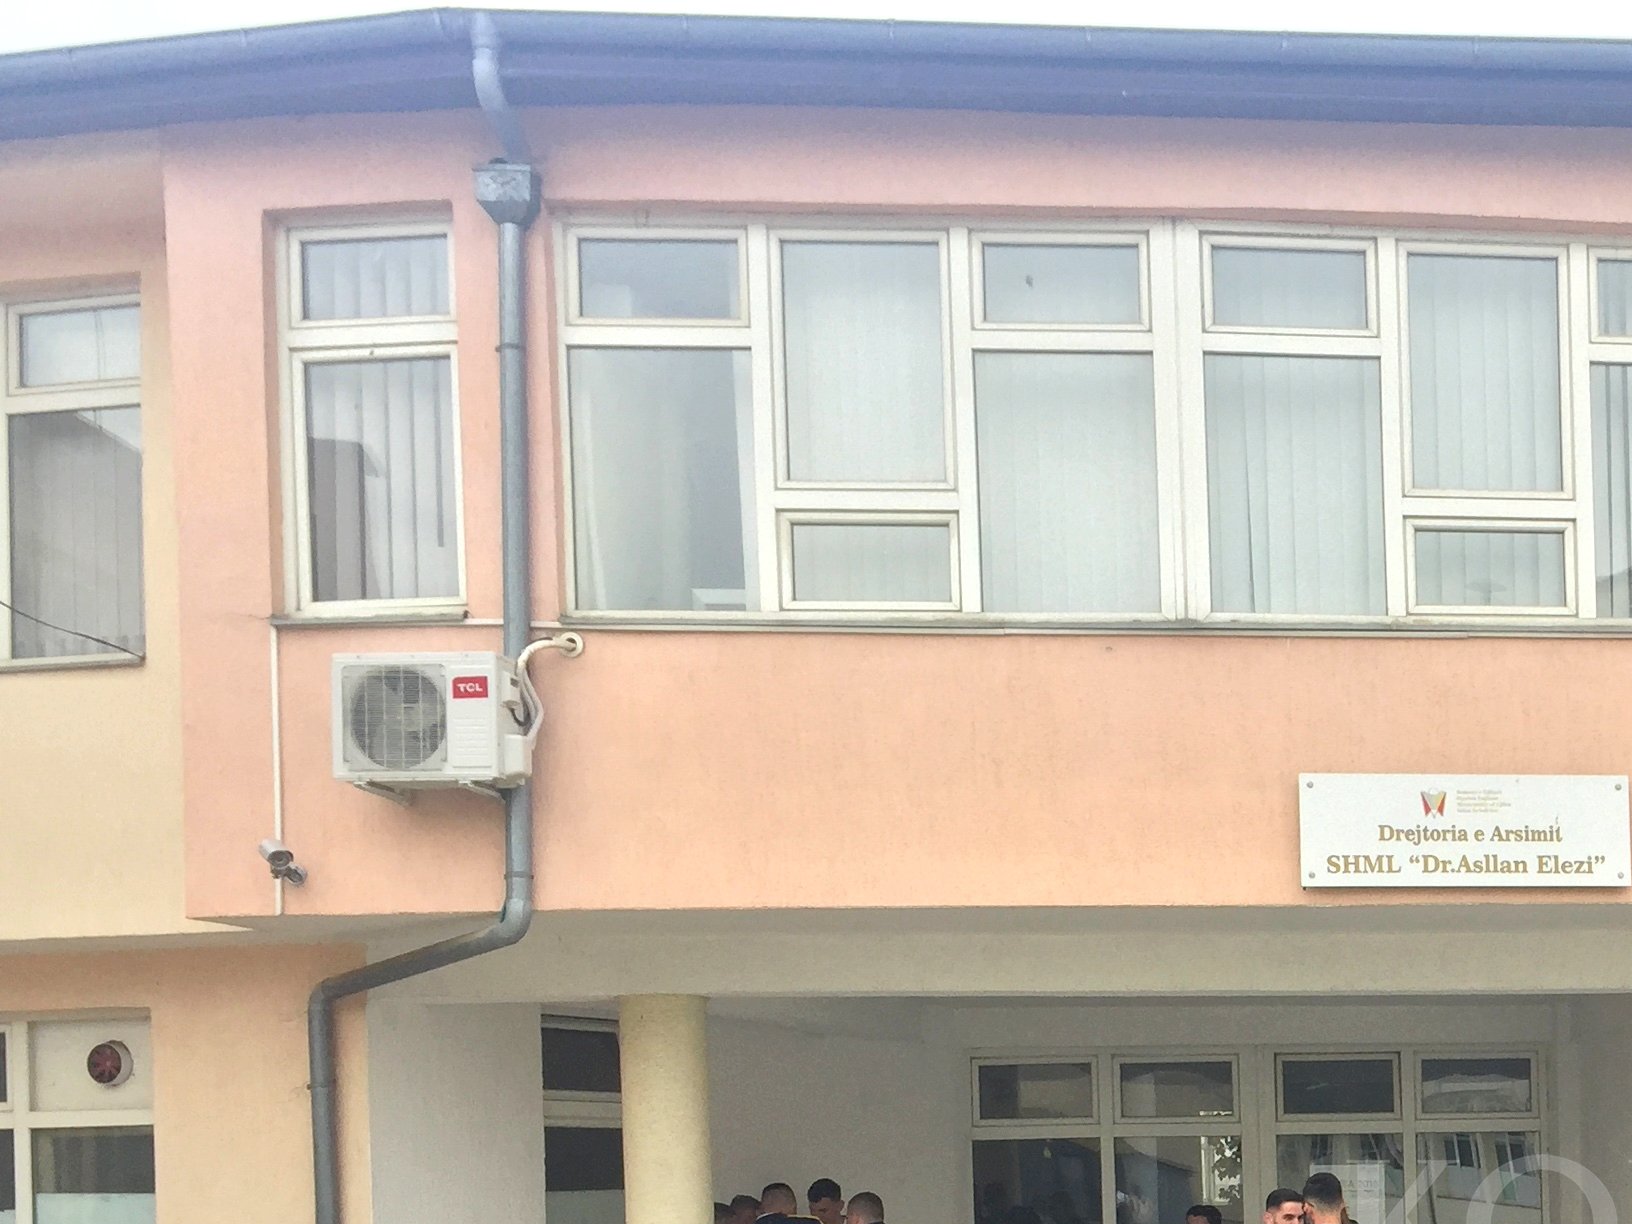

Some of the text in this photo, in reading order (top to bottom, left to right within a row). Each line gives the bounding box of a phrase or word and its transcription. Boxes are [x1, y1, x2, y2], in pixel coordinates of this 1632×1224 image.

[456, 683, 483, 694] TCL
[1377, 823, 1563, 846] Drejtoria e Arsimit
[1326, 854, 1402, 874] SHML
[1536, 855, 1606, 875] Elezi”
